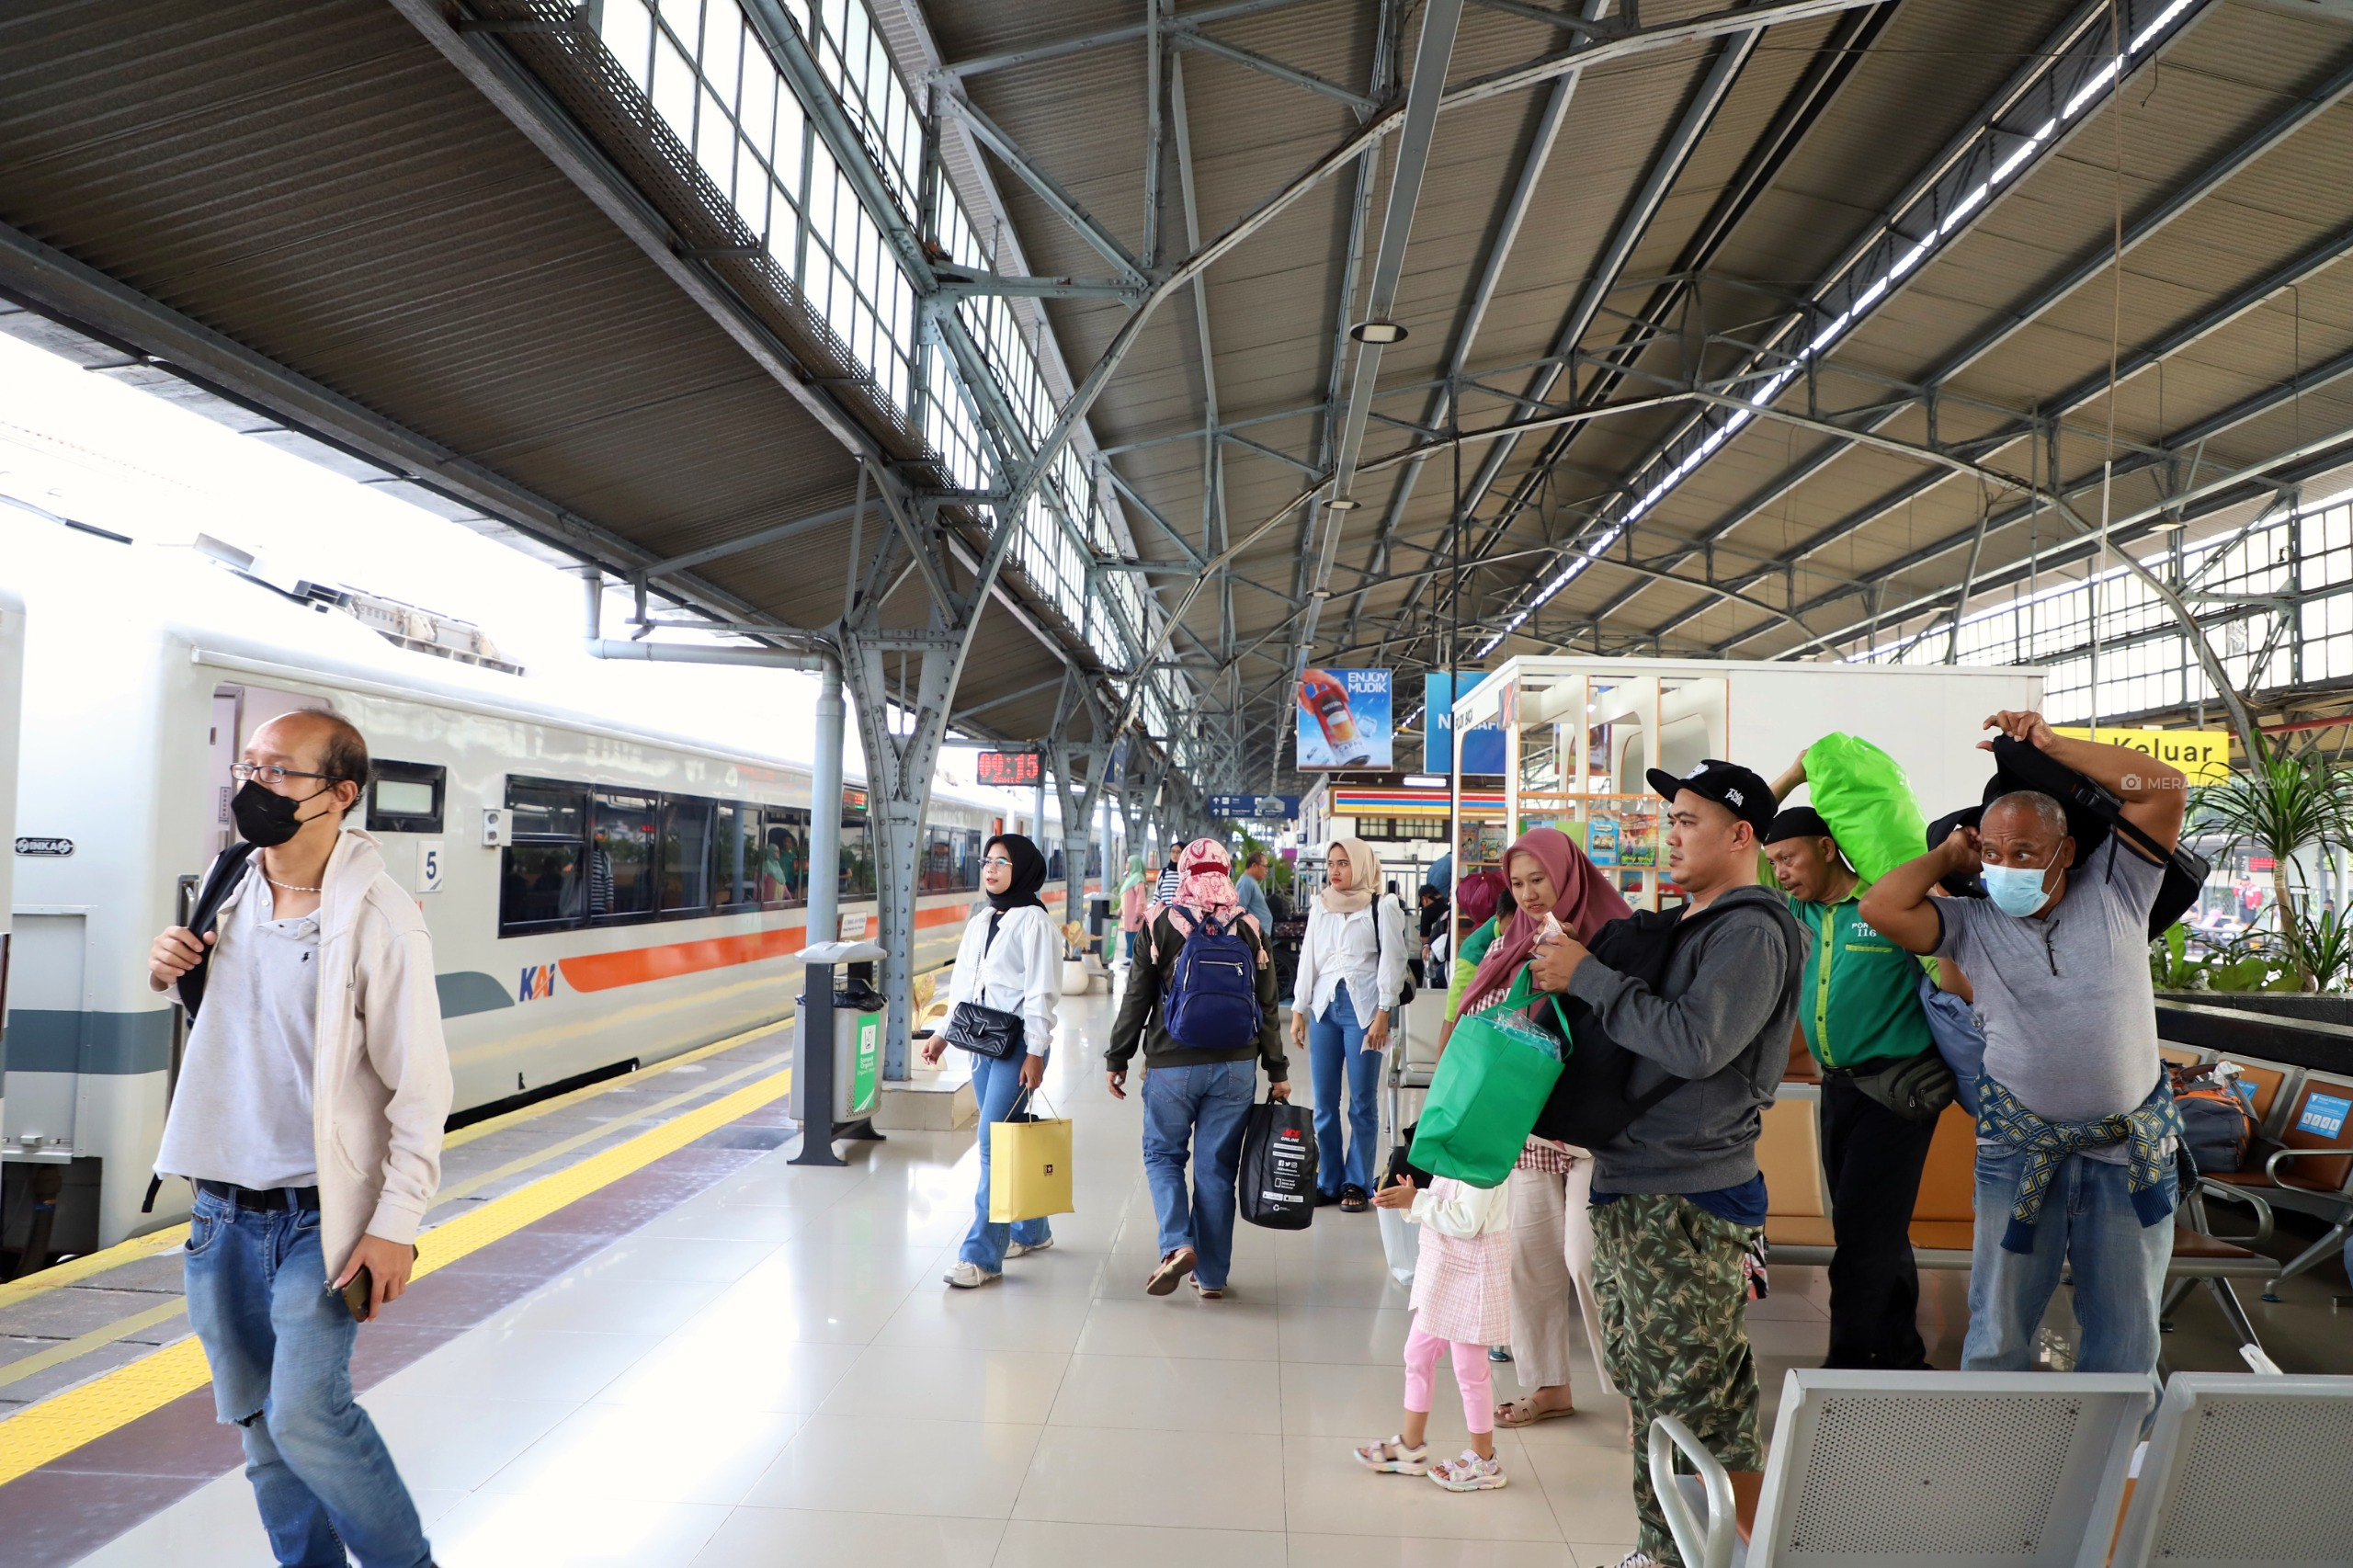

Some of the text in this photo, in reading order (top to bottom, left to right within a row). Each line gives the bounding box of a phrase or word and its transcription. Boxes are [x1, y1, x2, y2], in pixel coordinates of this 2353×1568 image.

[1347, 672, 1388, 683] ENJOY
[1347, 683, 1388, 693] MUDIK
[979, 753, 1039, 778] 09:15
[29, 841, 59, 851] INKA
[426, 851, 437, 880] 5
[1858, 928, 1877, 937] 116
[518, 963, 556, 1003] KAI
[1282, 1129, 1302, 1138] ACE
